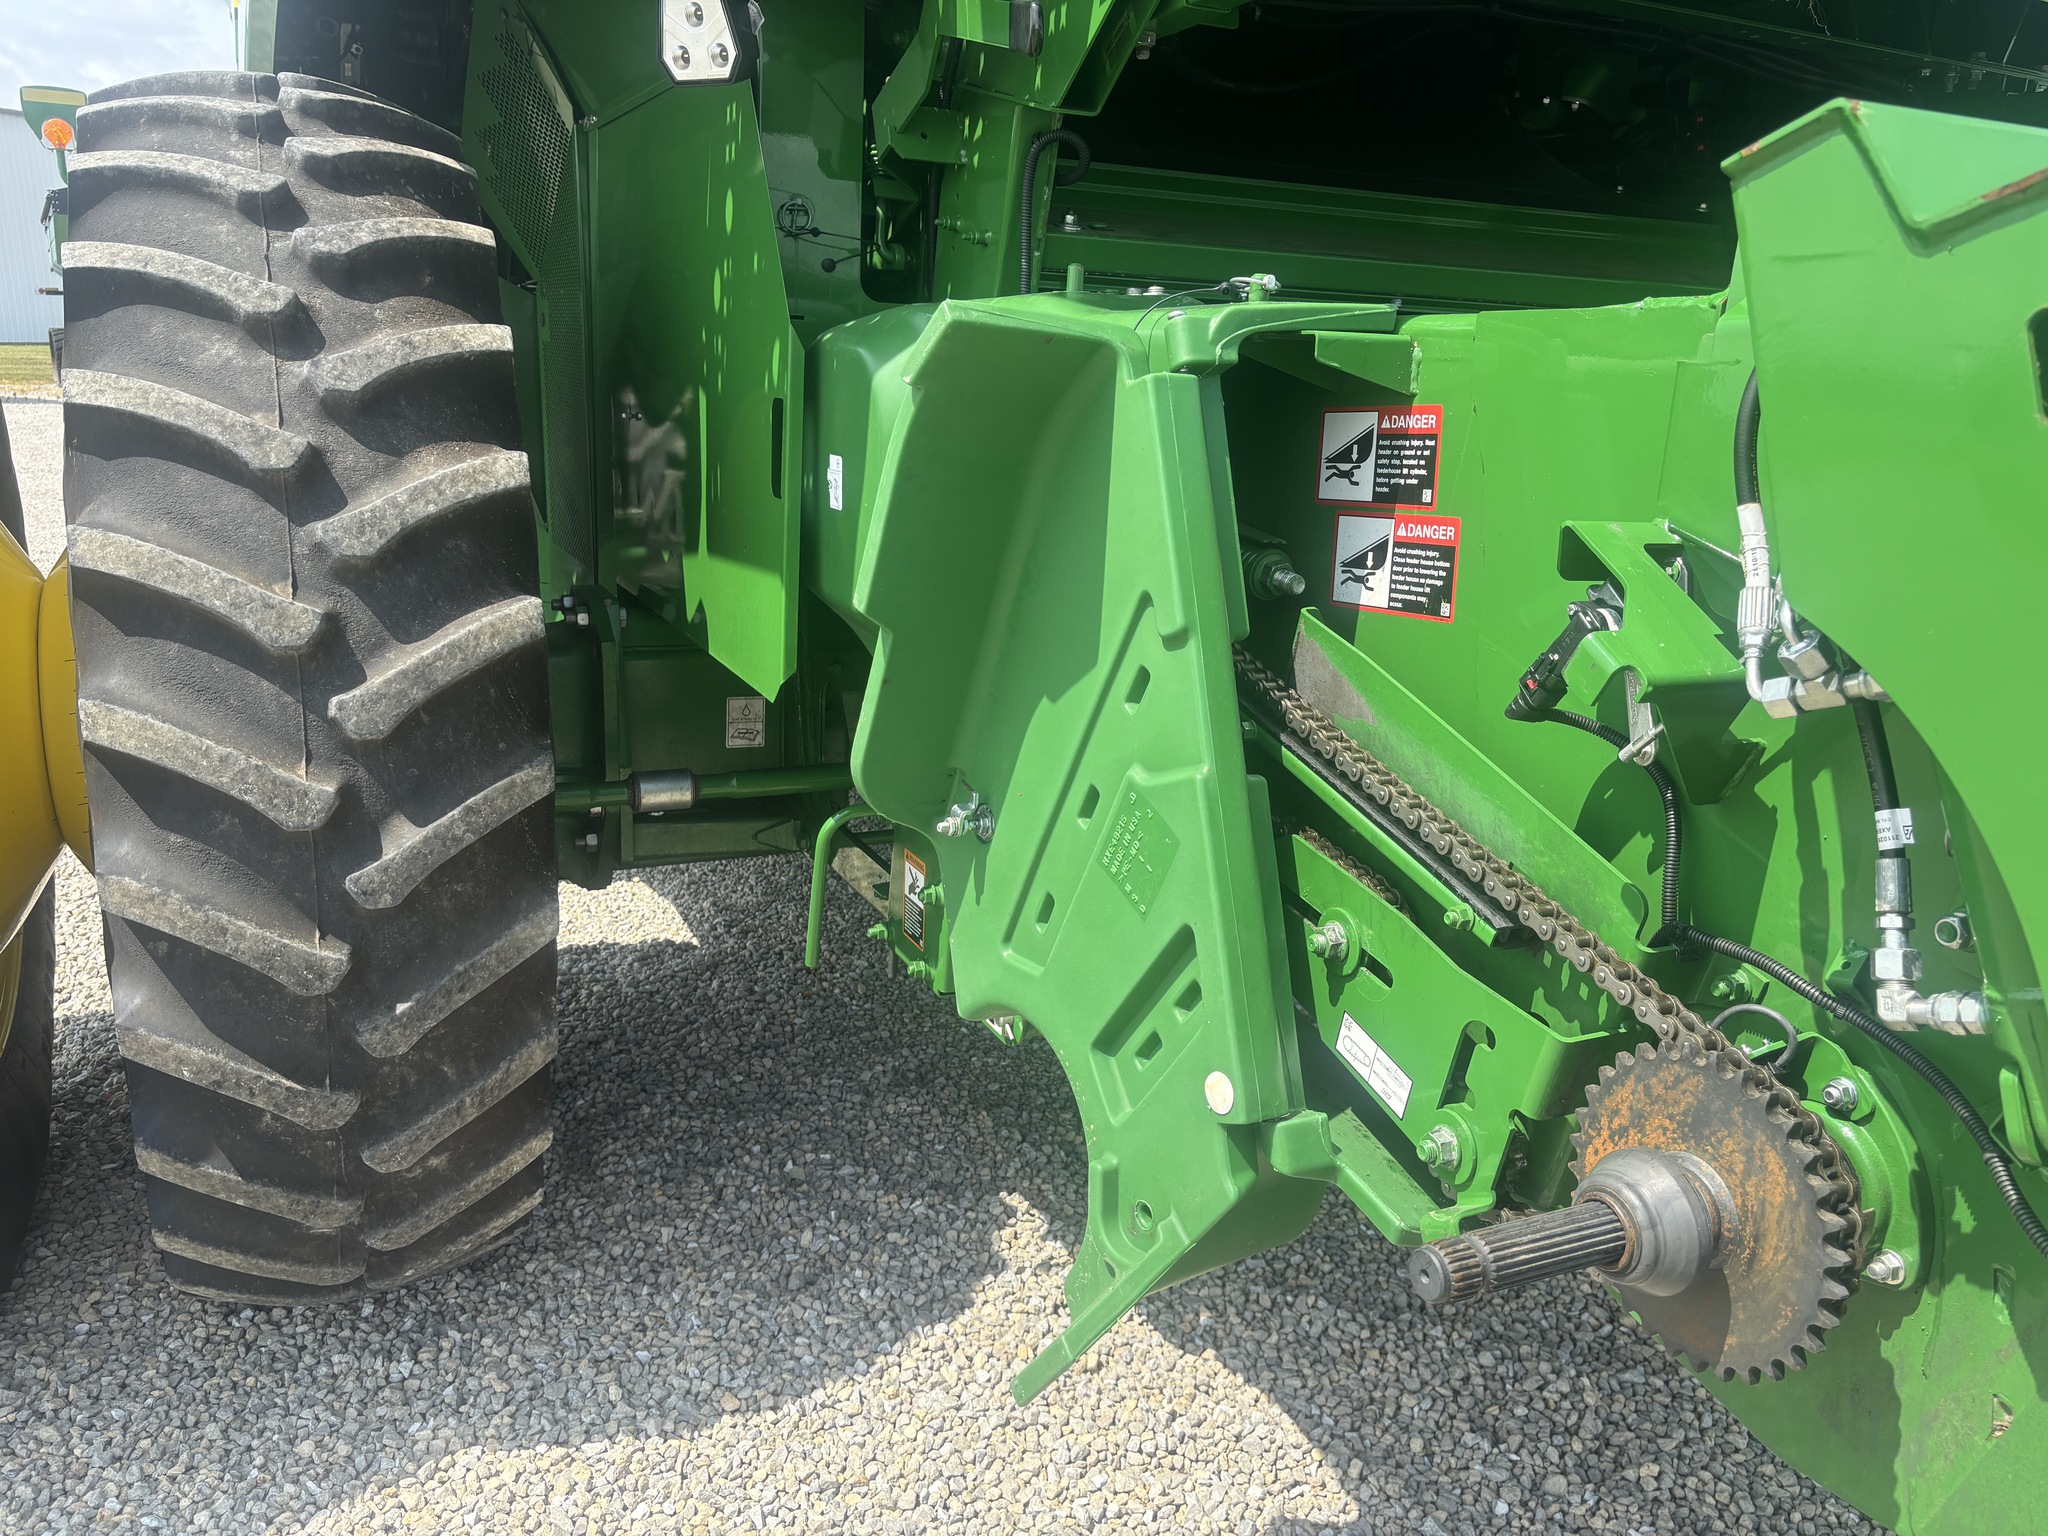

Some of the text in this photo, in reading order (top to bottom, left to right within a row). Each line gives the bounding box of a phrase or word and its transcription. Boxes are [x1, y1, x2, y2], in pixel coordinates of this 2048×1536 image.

[1391, 414, 1436, 428] DANGER
[1407, 524, 1455, 540] DANGER
[1420, 568, 1438, 577] lowering
[1426, 578, 1443, 586] damage
[1110, 810, 1142, 875] MADE IN USA
